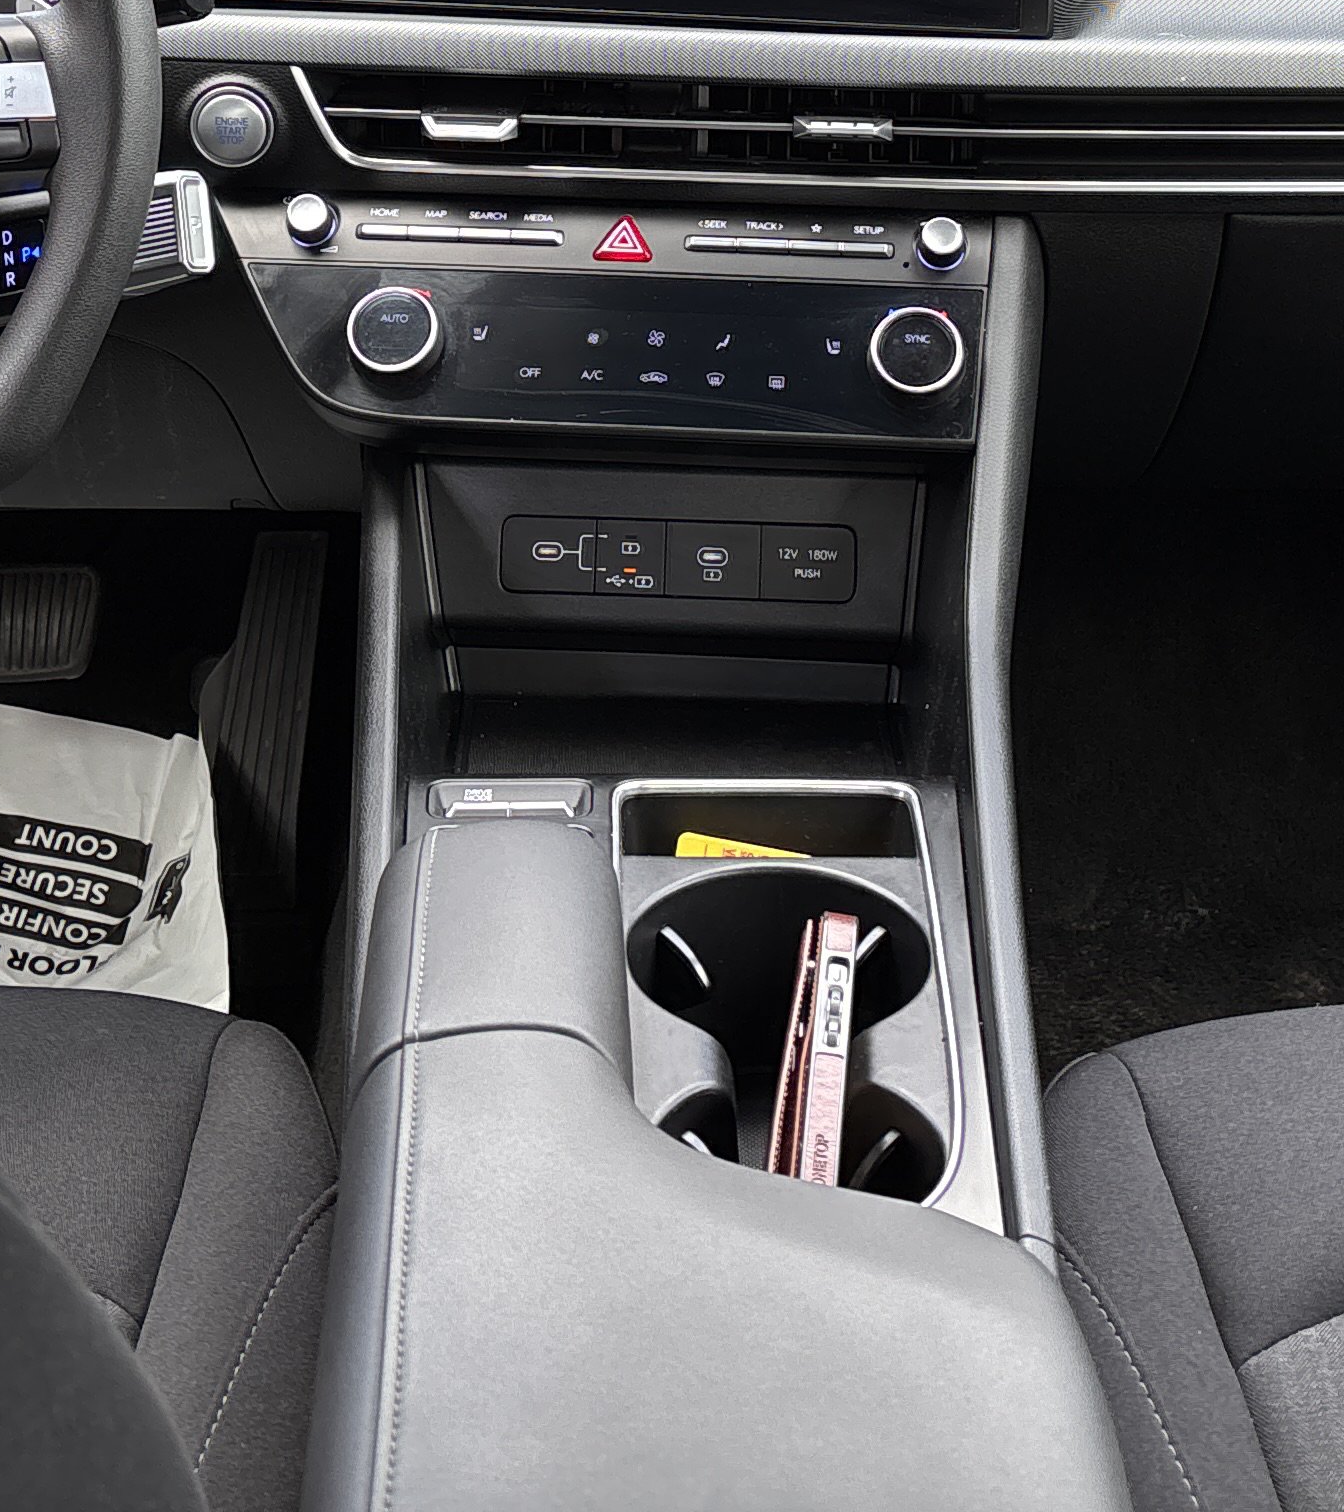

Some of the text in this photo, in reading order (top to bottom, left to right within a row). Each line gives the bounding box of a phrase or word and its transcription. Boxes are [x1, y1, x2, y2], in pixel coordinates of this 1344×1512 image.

[215, 116, 249, 126] ENGINE
[216, 126, 248, 136] START
[219, 136, 244, 145] STOP
[370, 207, 400, 218] HOME
[425, 209, 448, 219] MAP
[469, 211, 507, 221] SEARCH
[523, 213, 554, 223] MEDIA
[854, 225, 885, 235] SETUP
[1, 230, 13, 245] D
[3, 251, 15, 266] N
[21, 246, 31, 262] P
[5, 271, 16, 287] R
[380, 313, 409, 324] AUTO
[905, 334, 931, 344] SYNC
[519, 367, 542, 378] OFF
[581, 370, 604, 381] A/C
[778, 548, 838, 561] 12V 180W
[794, 568, 821, 579] PUSH
[13, 824, 118, 861] COUNT
[7, 947, 99, 975] LOOR
